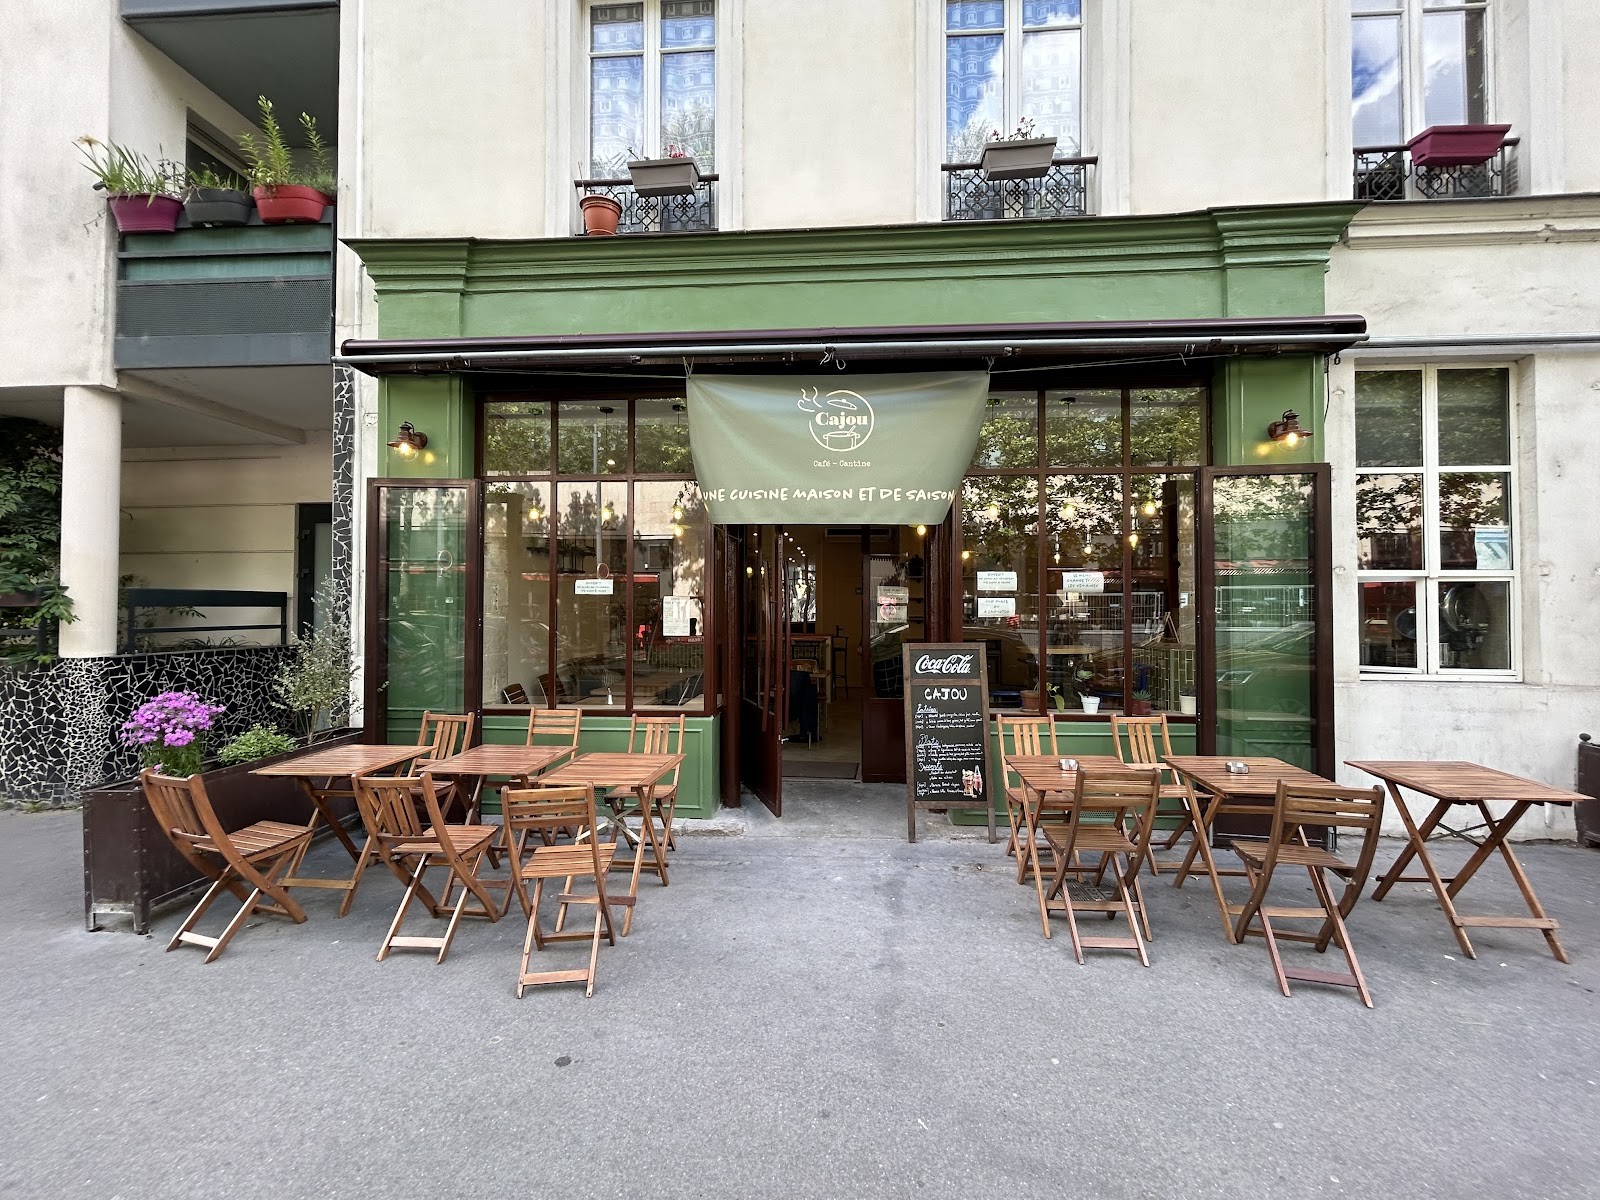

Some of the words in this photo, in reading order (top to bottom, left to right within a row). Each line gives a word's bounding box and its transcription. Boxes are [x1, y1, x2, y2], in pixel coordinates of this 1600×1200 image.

[815, 411, 868, 430] Cajou
[703, 488, 726, 502] UNE
[729, 487, 789, 501] CUISINE
[792, 488, 853, 501] MAISON
[859, 486, 877, 502] ET
[879, 487, 902, 502] DE
[905, 488, 955, 502] SAISON
[915, 654, 974, 674] Coca-Cola
[924, 687, 968, 701] CAJOU
